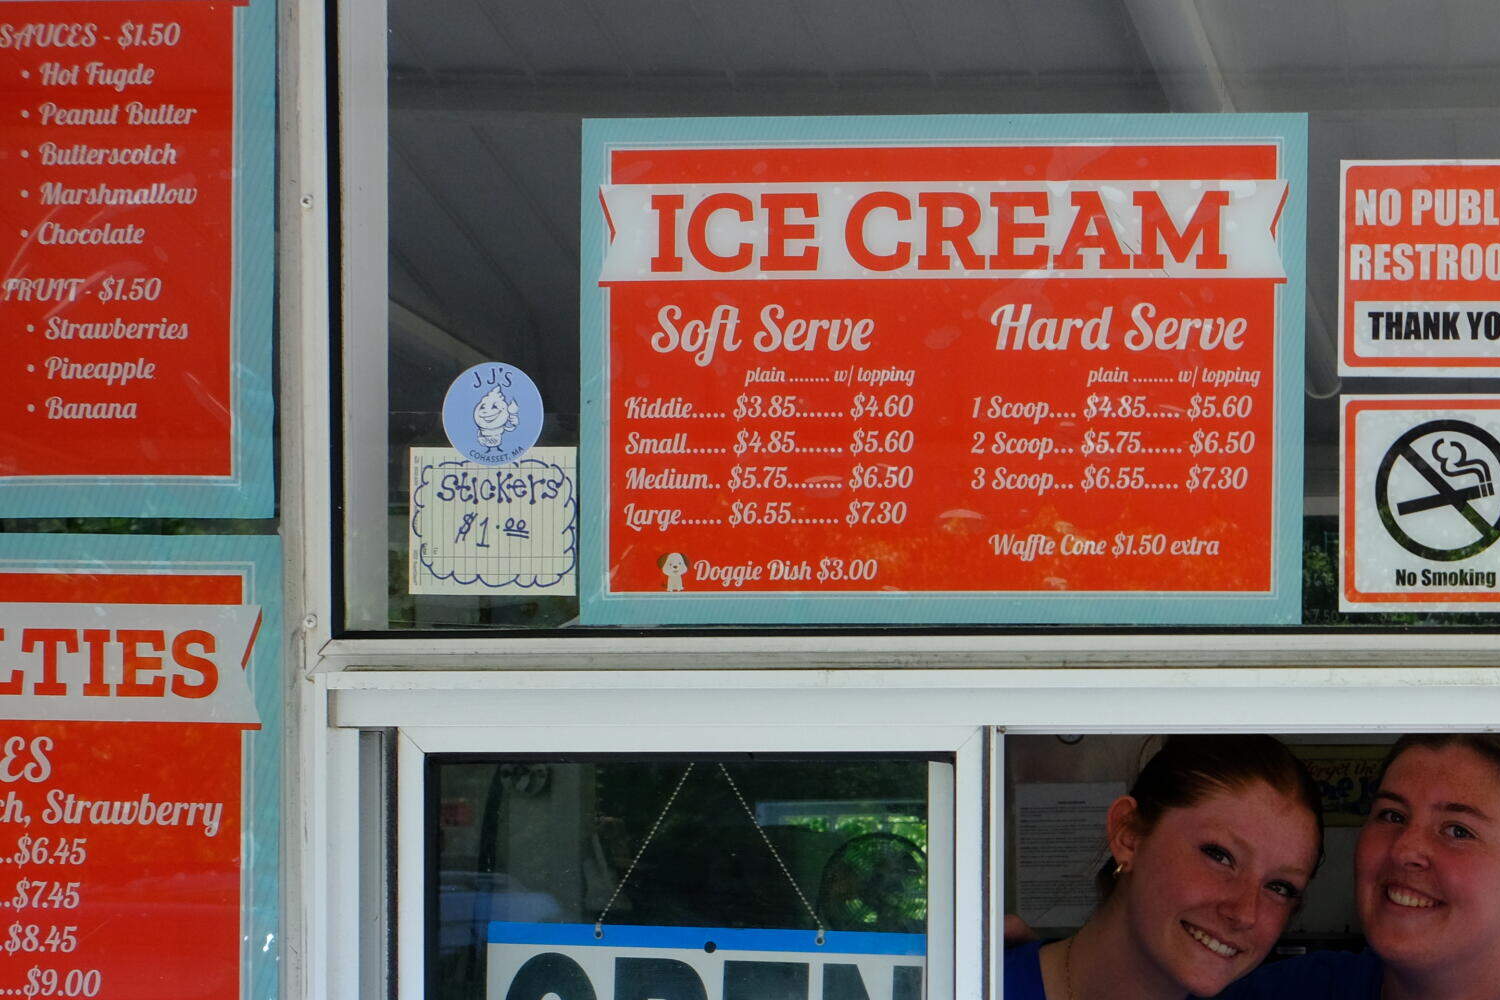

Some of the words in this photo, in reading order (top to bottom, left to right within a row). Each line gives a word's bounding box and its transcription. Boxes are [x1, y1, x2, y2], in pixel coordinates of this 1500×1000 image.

[0, 22, 97, 47] SAUCES
[118, 21, 181, 49] $1.50
[39, 62, 80, 86] Hot
[84, 63, 154, 92] Fugde
[38, 103, 120, 126] Peanut
[126, 103, 197, 126] Butter
[39, 143, 176, 165] Butterscotch
[40, 182, 197, 206] Marshmallow
[1355, 189, 1401, 226] NO
[38, 222, 145, 246] Chocolate
[650, 191, 820, 273] ICE
[844, 189, 1230, 272] CREAM
[2, 276, 84, 302] FRUIT
[99, 276, 162, 305] $1.50
[45, 317, 188, 340] Strawberries
[651, 304, 742, 367] Soft
[753, 306, 875, 352] Serve
[990, 302, 1110, 352] Hard
[1123, 302, 1248, 351] Serve
[1369, 312, 1462, 340] THANK
[45, 357, 155, 385] Pineapple
[745, 367, 785, 385] plain
[834, 365, 854, 386] w/
[857, 367, 915, 387] topping
[1087, 367, 1128, 385] plain
[1177, 365, 1198, 386] w/
[1201, 367, 1260, 387] topping
[45, 397, 137, 420] Banana
[437, 471, 562, 504] Stickers
[988, 532, 1056, 560] Waffle
[1061, 535, 1106, 557] Cone
[1111, 532, 1166, 558] $1.50
[1170, 535, 1219, 556] extra
[694, 558, 766, 587] Doggie
[770, 558, 812, 582] Dish
[817, 558, 878, 583] $3.00
[1395, 569, 1416, 586] No
[1421, 569, 1496, 588] Smoking
[42, 789, 223, 838] Strawberry
